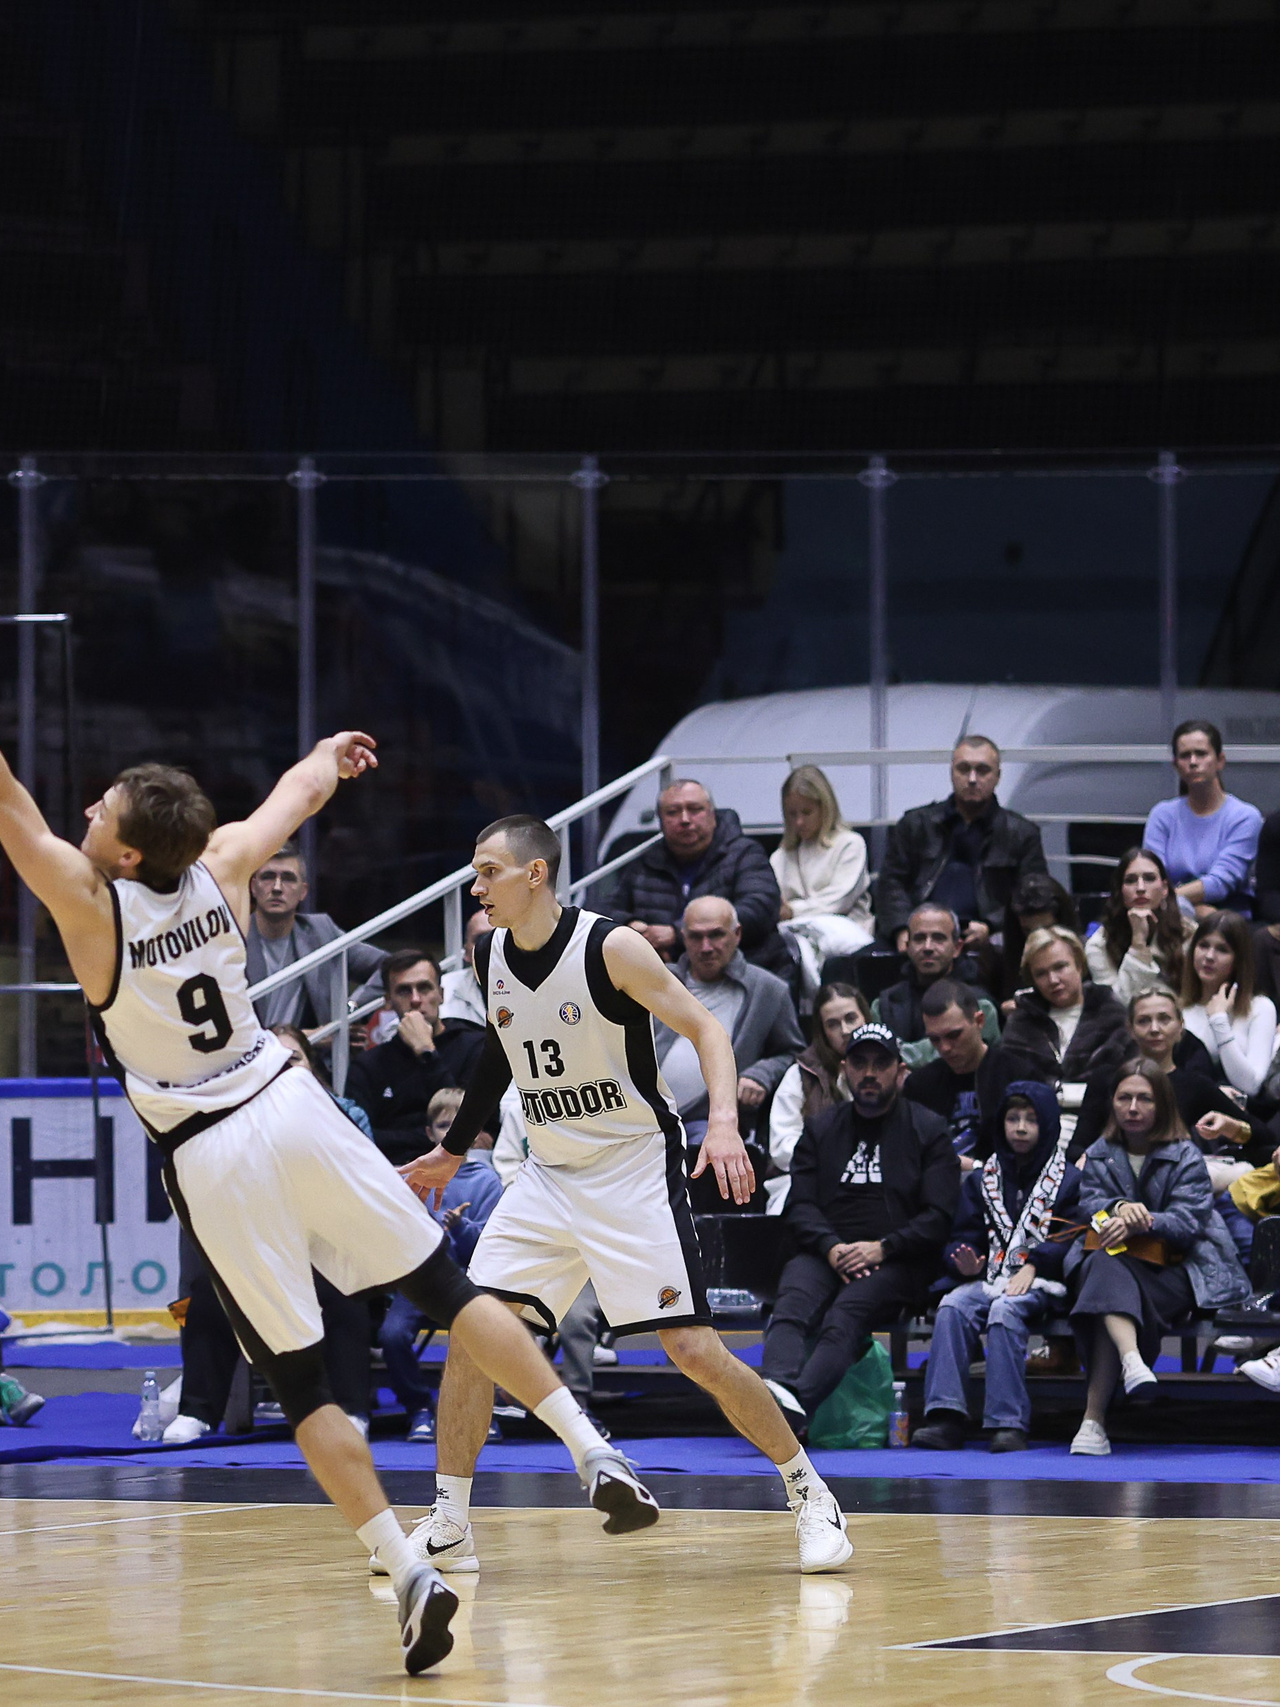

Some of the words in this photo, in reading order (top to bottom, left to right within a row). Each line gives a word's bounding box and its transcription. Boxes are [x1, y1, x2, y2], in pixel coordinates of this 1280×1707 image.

[128, 904, 230, 969] MOTOVILOV
[177, 973, 233, 1054] 9
[523, 1039, 566, 1078] 13
